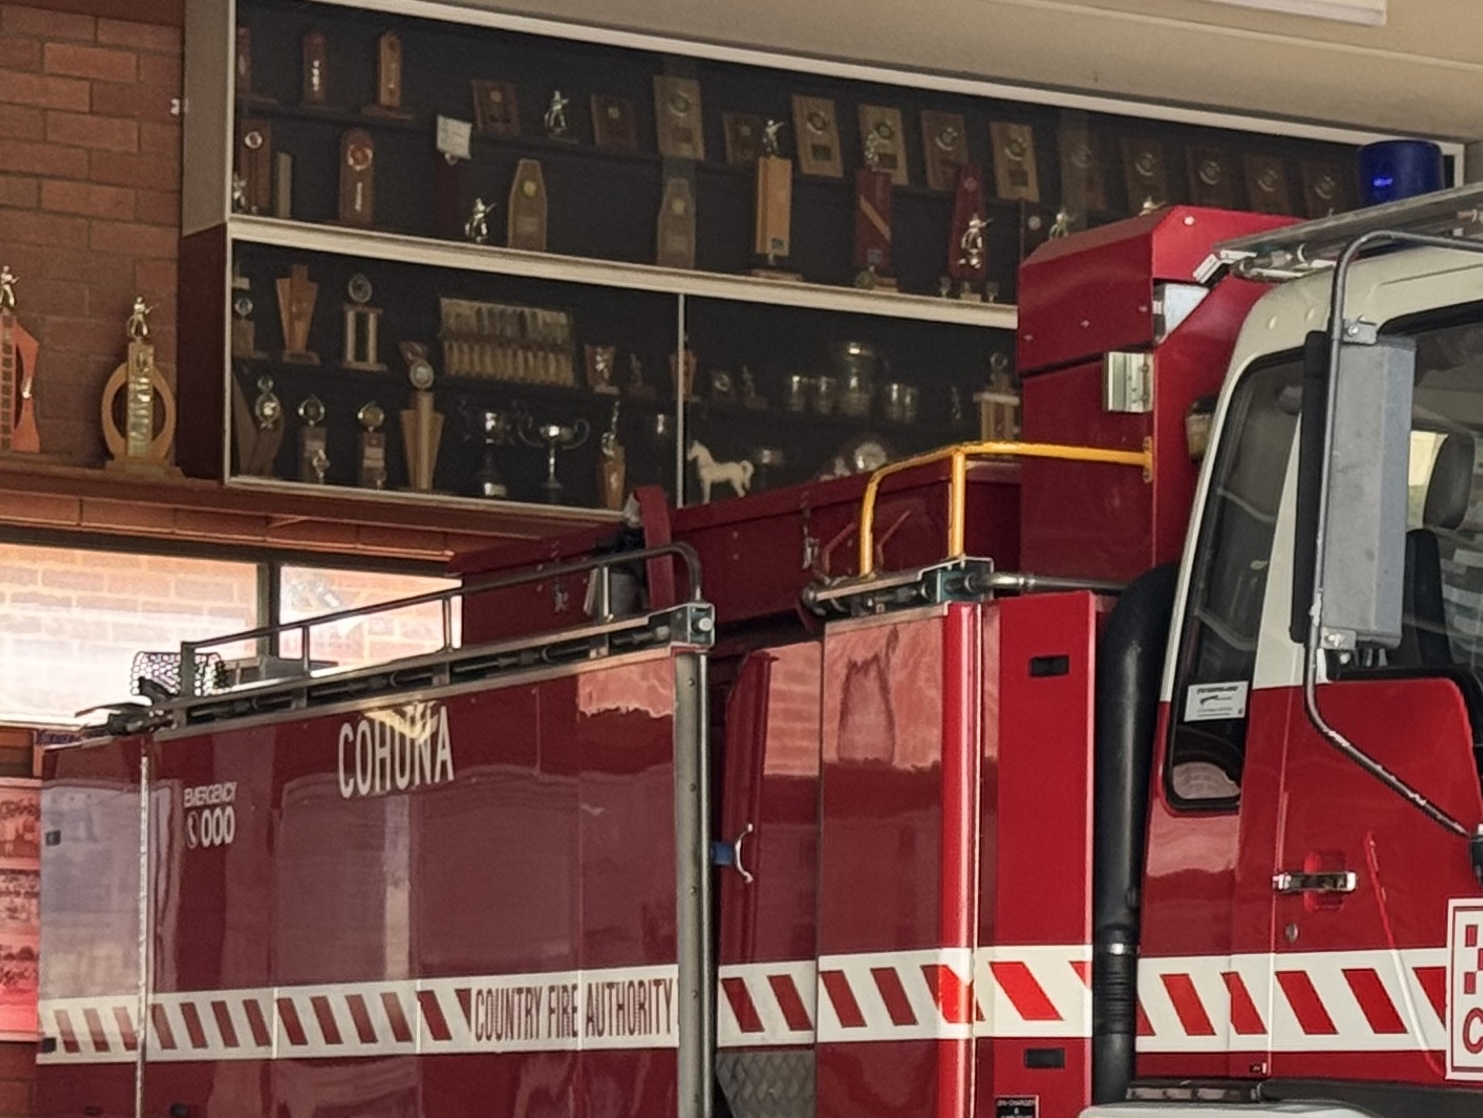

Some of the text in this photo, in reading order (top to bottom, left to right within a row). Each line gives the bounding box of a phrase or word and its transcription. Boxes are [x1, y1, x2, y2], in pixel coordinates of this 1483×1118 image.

[339, 705, 454, 799] COHUNA
[201, 806, 235, 848] 000
[475, 978, 673, 1042] COUNTRY FIRE AUTHORITY
